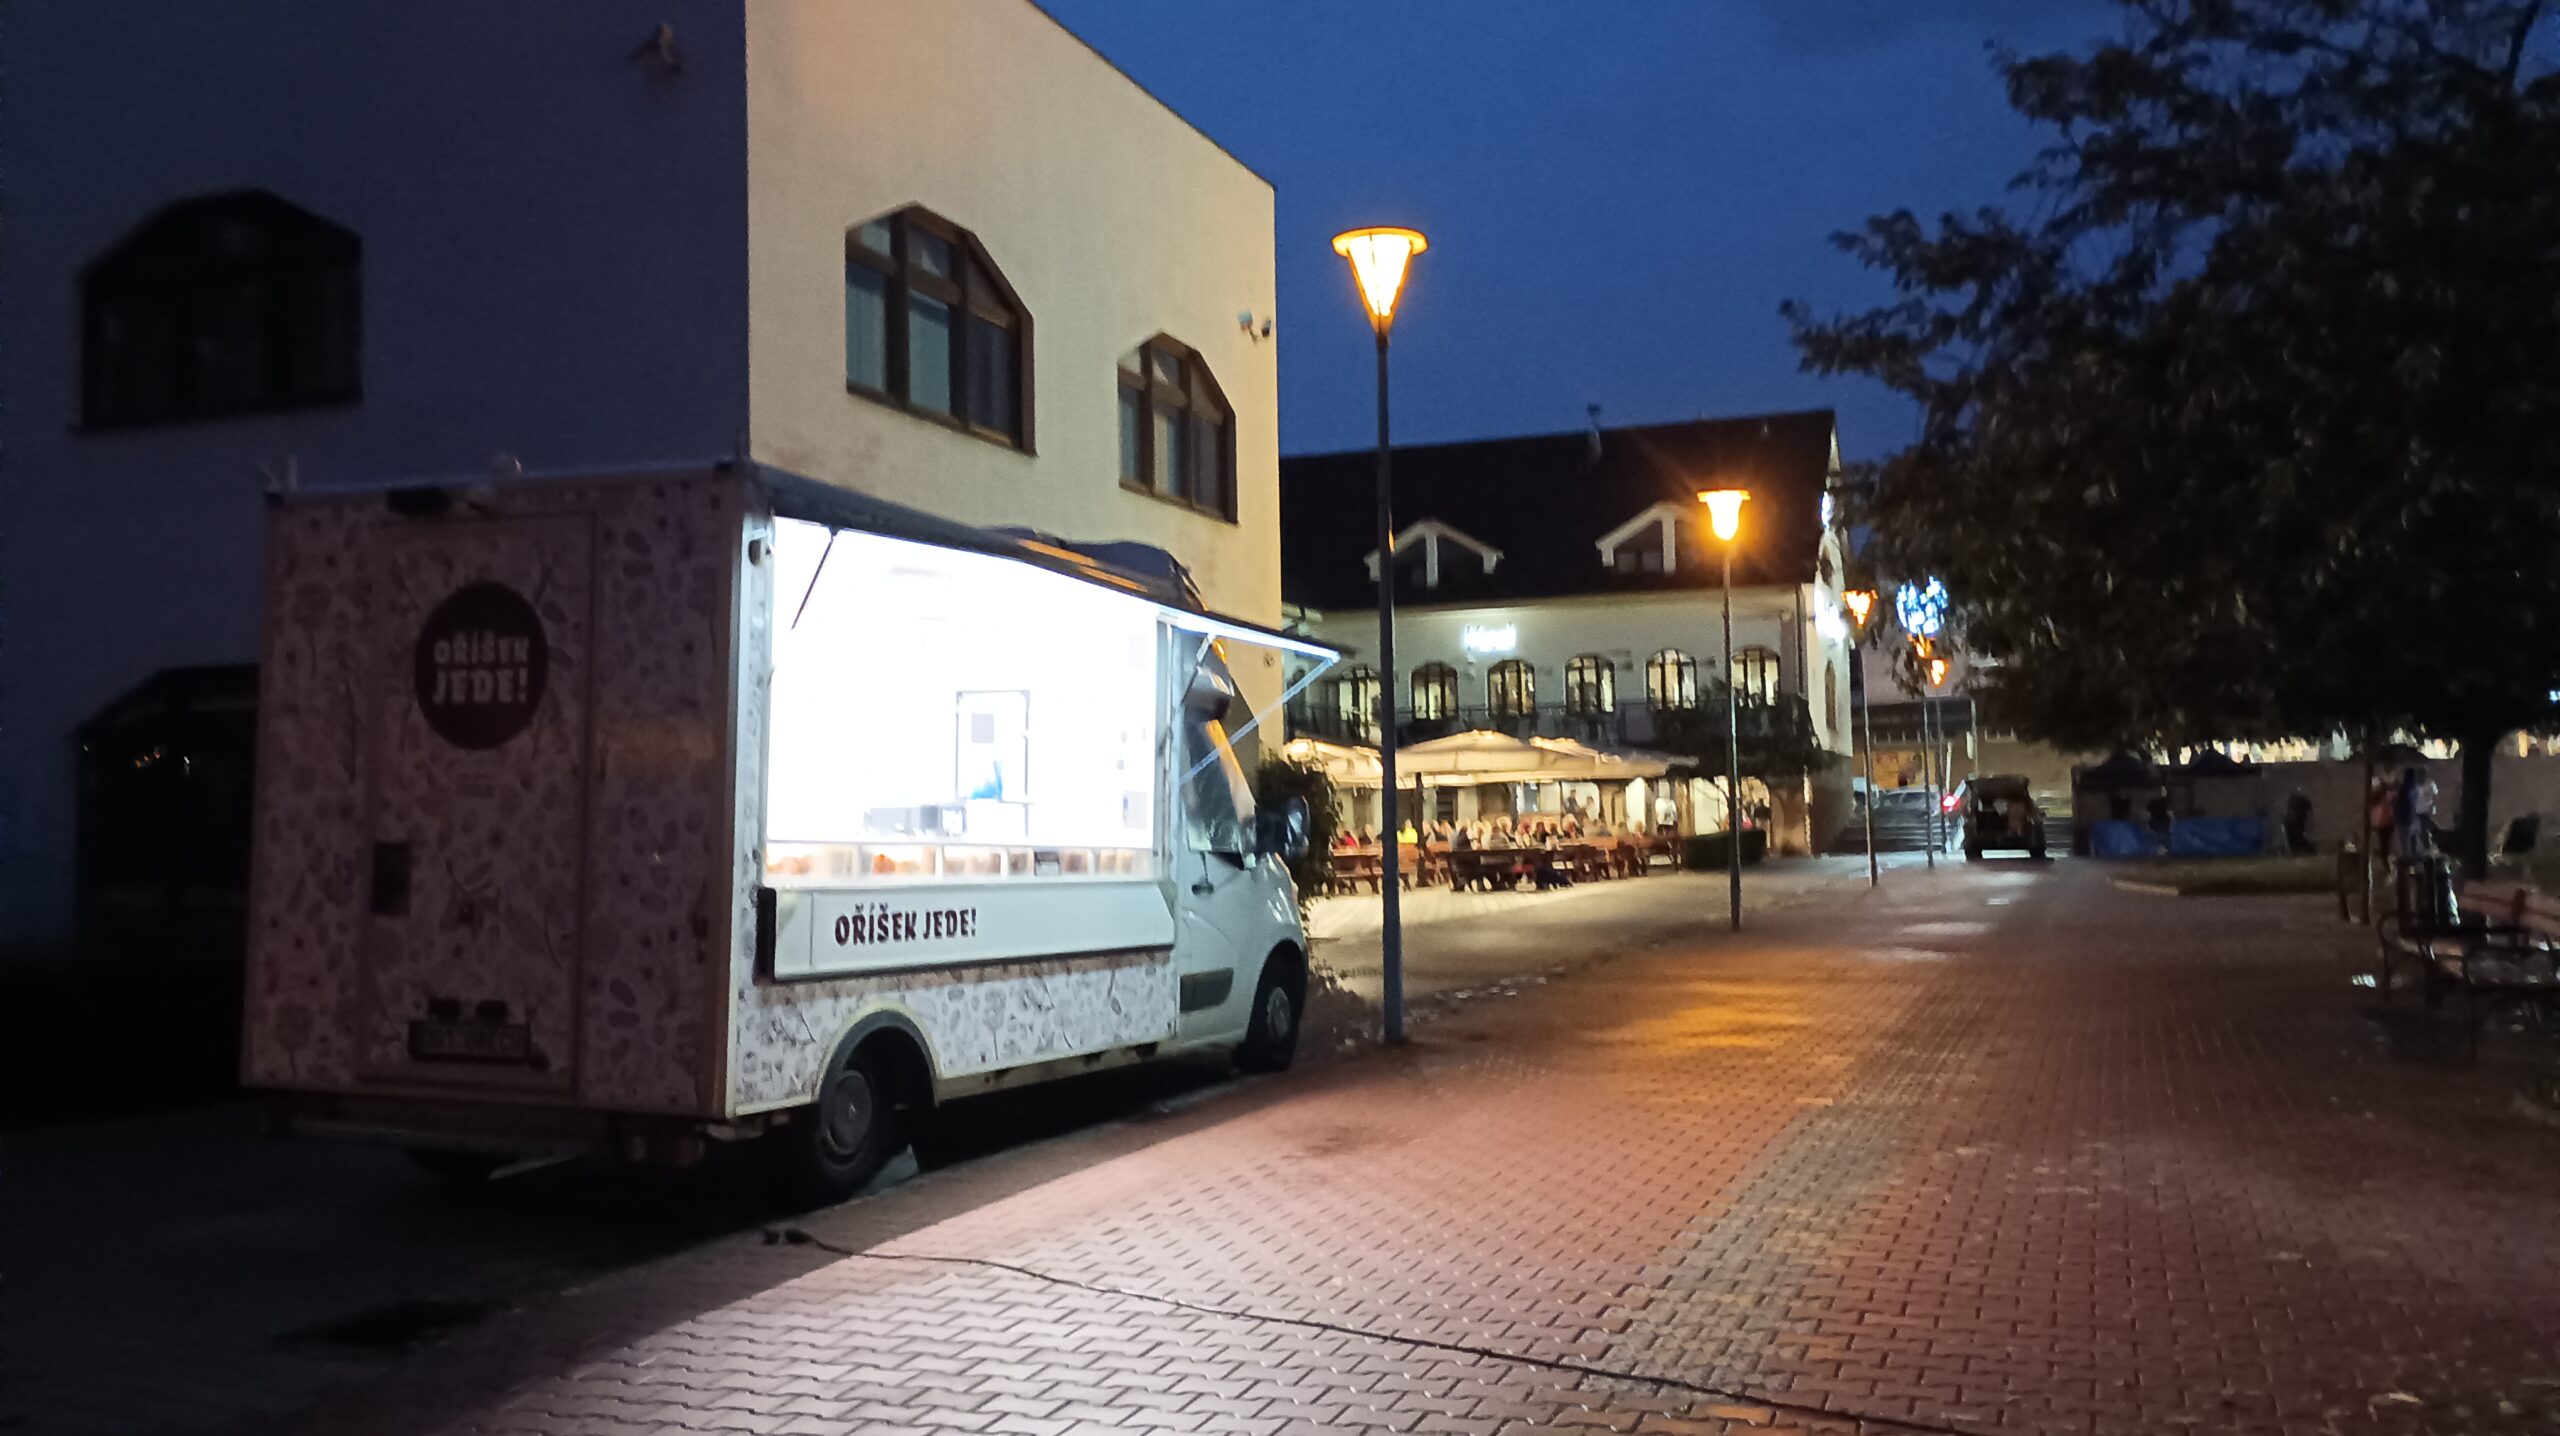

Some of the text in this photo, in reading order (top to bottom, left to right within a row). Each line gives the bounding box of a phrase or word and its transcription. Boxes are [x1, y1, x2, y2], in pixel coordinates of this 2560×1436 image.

[432, 667, 529, 704] JEDE!
[834, 902, 977, 946] OŘÍŠEK JEDE!
